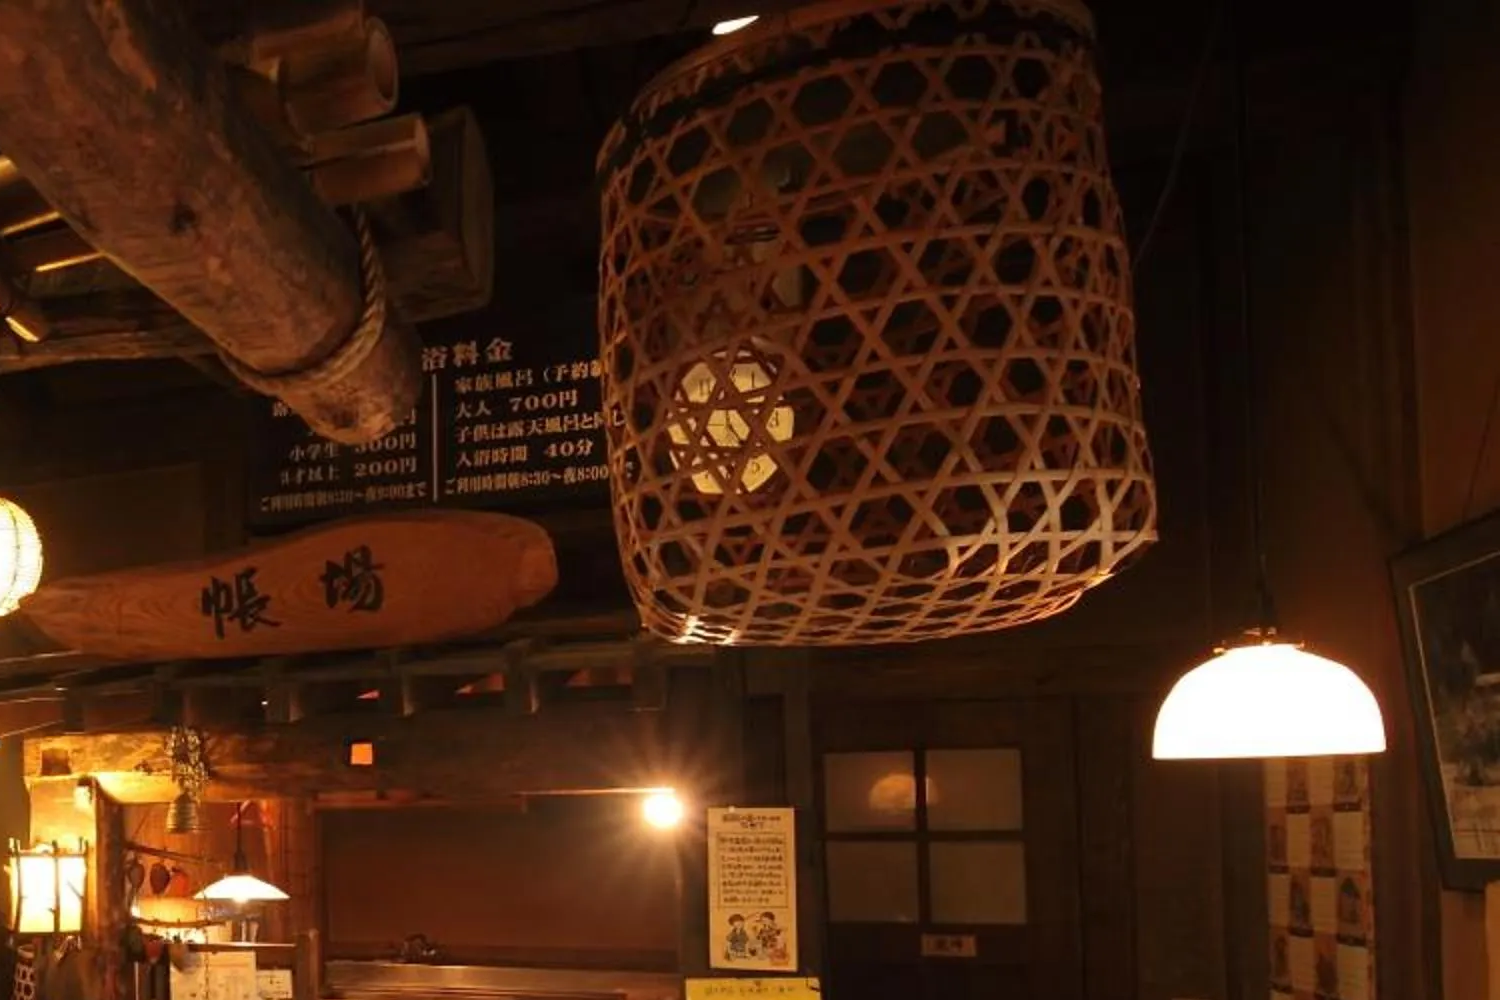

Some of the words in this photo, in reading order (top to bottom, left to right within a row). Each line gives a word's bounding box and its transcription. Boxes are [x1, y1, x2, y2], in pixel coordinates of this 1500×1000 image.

[456, 400, 492, 420] 大人
[509, 388, 579, 412] 700円
[354, 455, 418, 479] 200円
[456, 444, 529, 470] 入浴時間
[546, 438, 595, 458] 40分
[202, 545, 386, 639] 帳場
